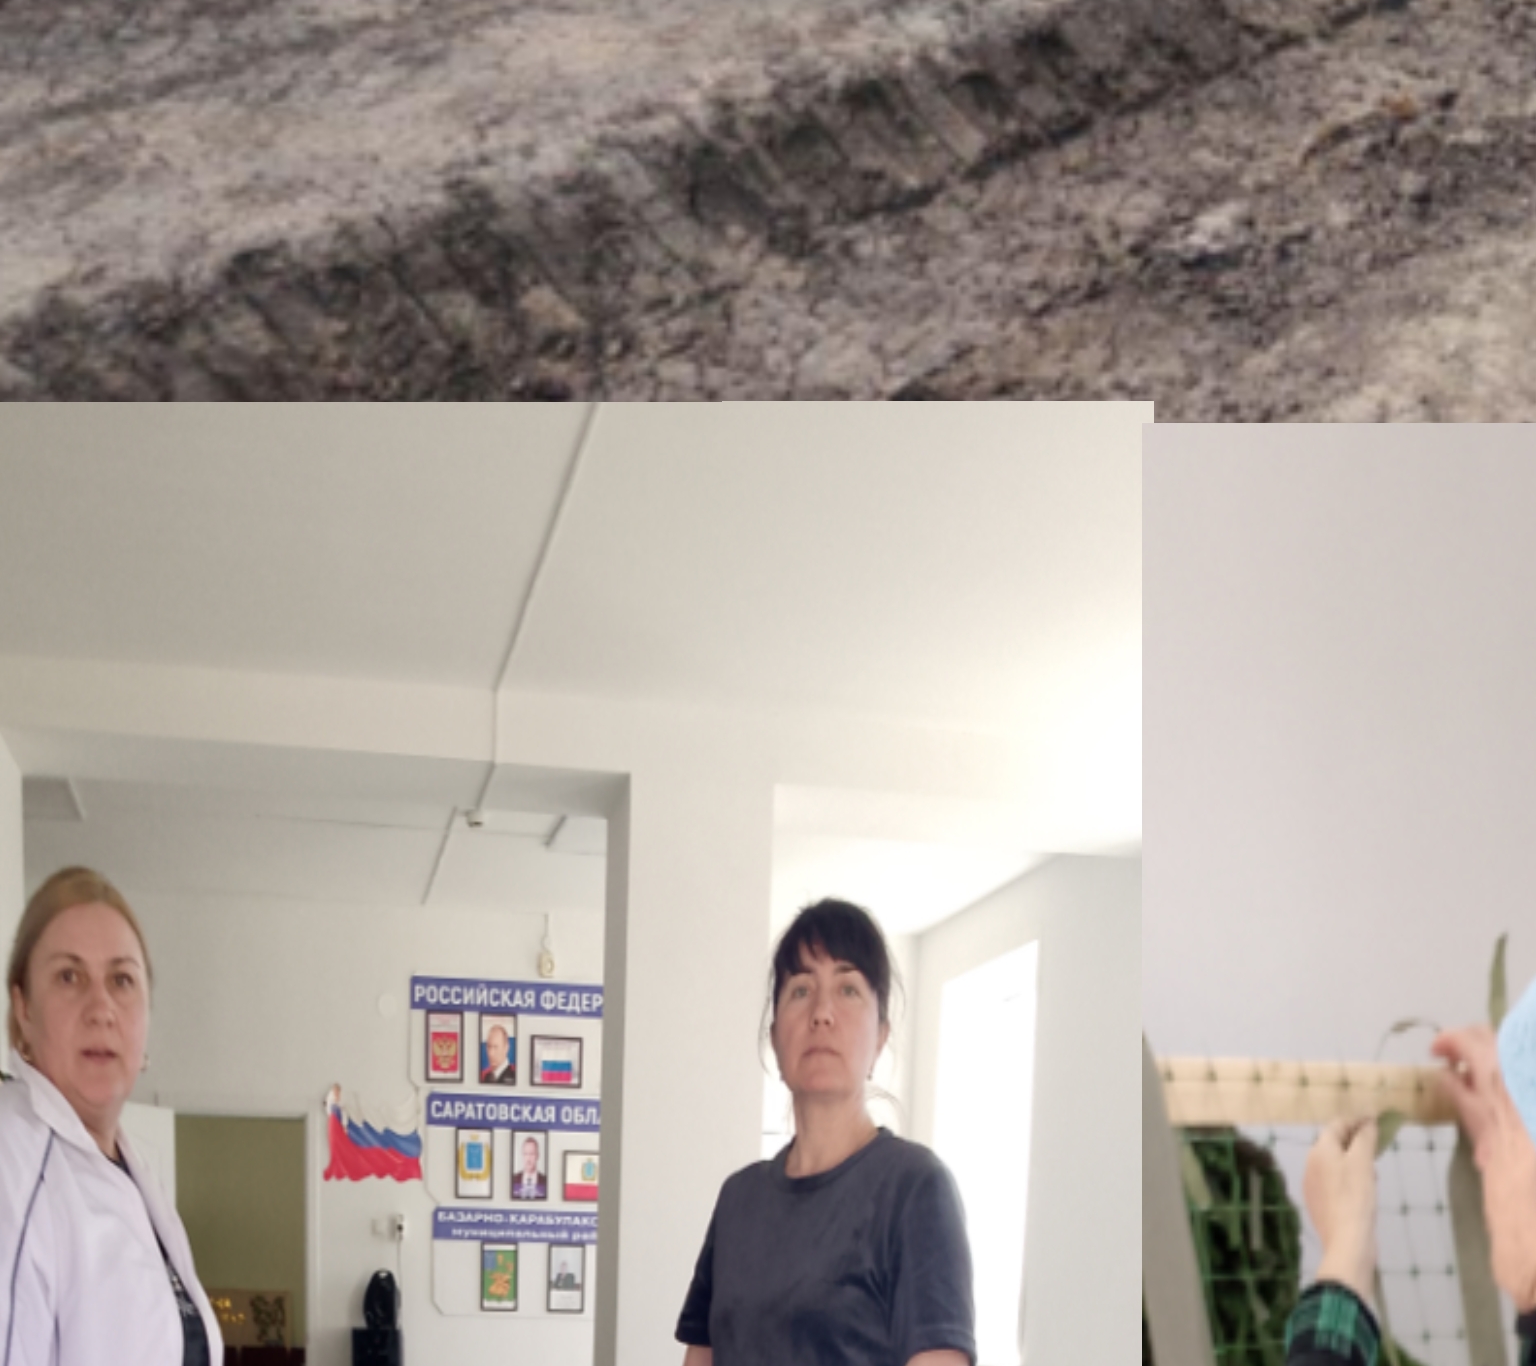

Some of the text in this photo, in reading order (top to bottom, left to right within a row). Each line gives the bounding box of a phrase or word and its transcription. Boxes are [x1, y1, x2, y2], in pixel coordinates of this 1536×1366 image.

[413, 983, 603, 1015] РОССИЙСКАЯ ФЕДЕР
[430, 1101, 600, 1126] САРАТОВСКАЯ ОБЛ
